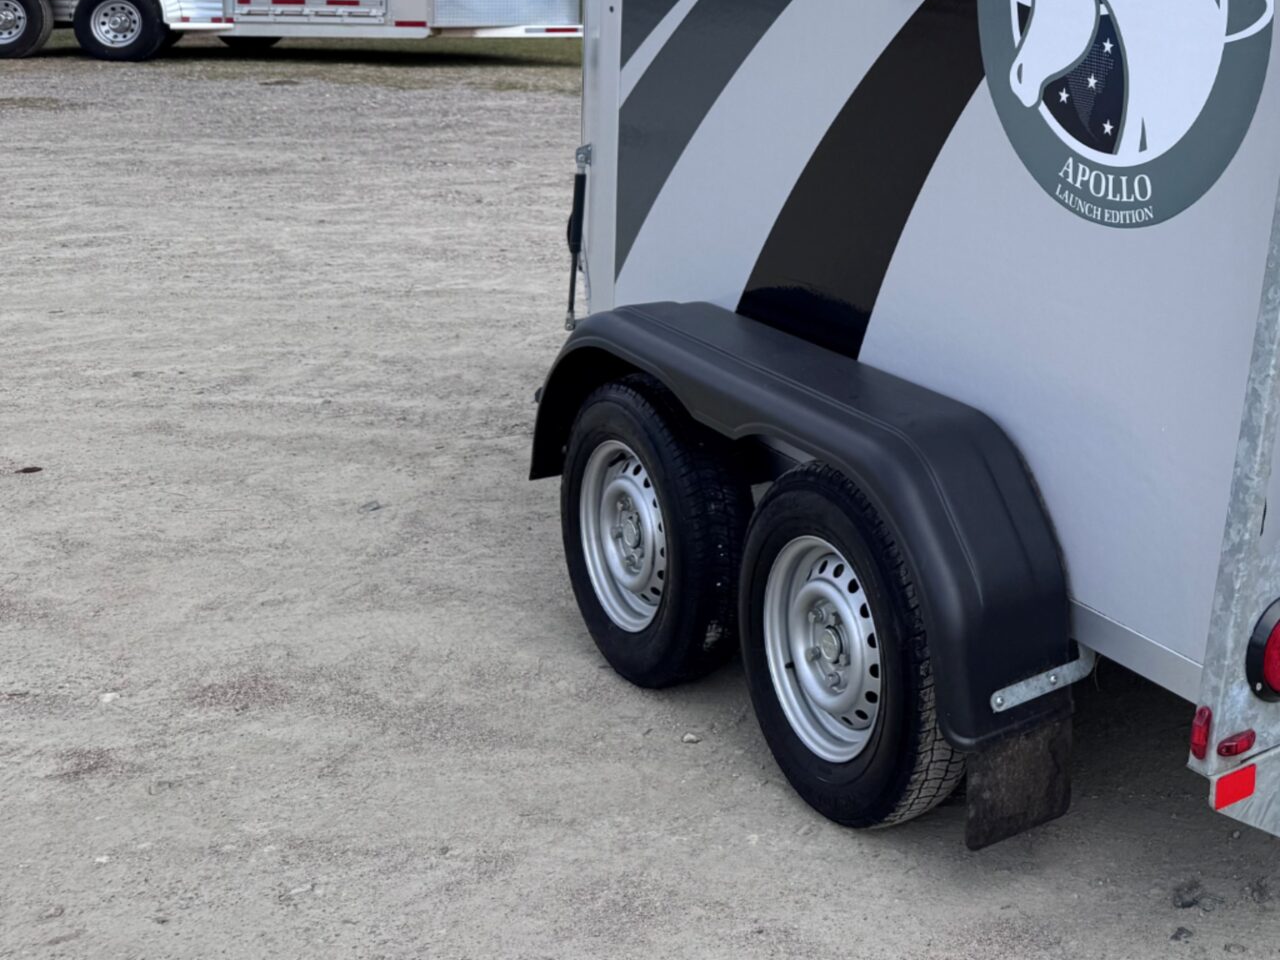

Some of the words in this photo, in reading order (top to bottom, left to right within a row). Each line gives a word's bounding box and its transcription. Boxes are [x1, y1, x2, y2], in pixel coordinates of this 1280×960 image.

[1058, 156, 1152, 202] APOLLO
[1055, 183, 1101, 221] LAUNCH
[1104, 205, 1154, 224] EDITION
